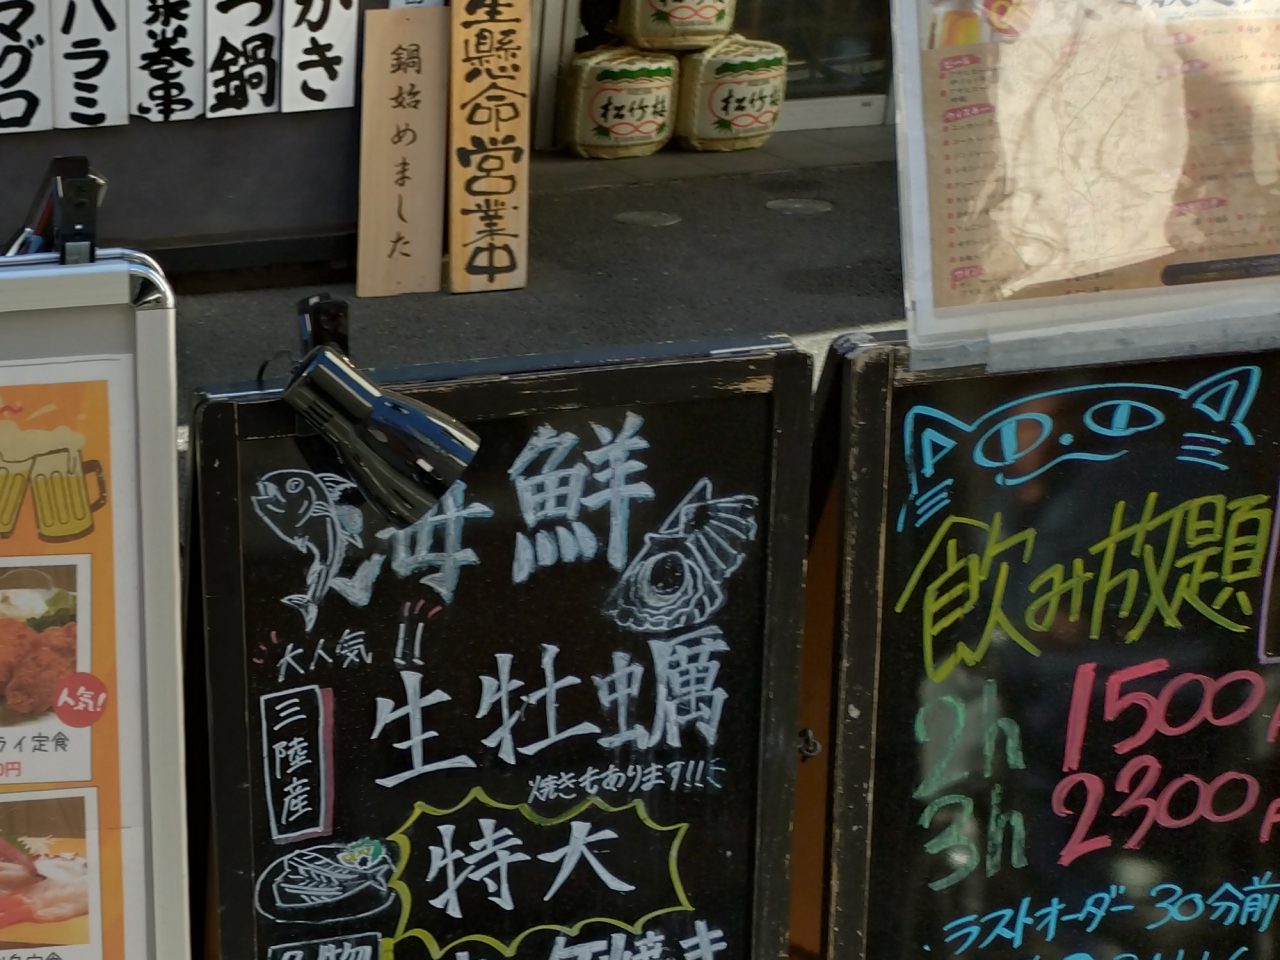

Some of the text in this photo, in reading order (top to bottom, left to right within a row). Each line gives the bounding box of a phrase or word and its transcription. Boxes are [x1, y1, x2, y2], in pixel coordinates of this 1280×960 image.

[61, 0, 117, 125] ハラミ
[387, 43, 423, 259] 鍋始めました
[895, 491, 1272, 683] 飲み放題
[272, 698, 314, 826] 三陸産
[369, 626, 731, 789] 生牡蠣
[426, 818, 637, 919] 特大
